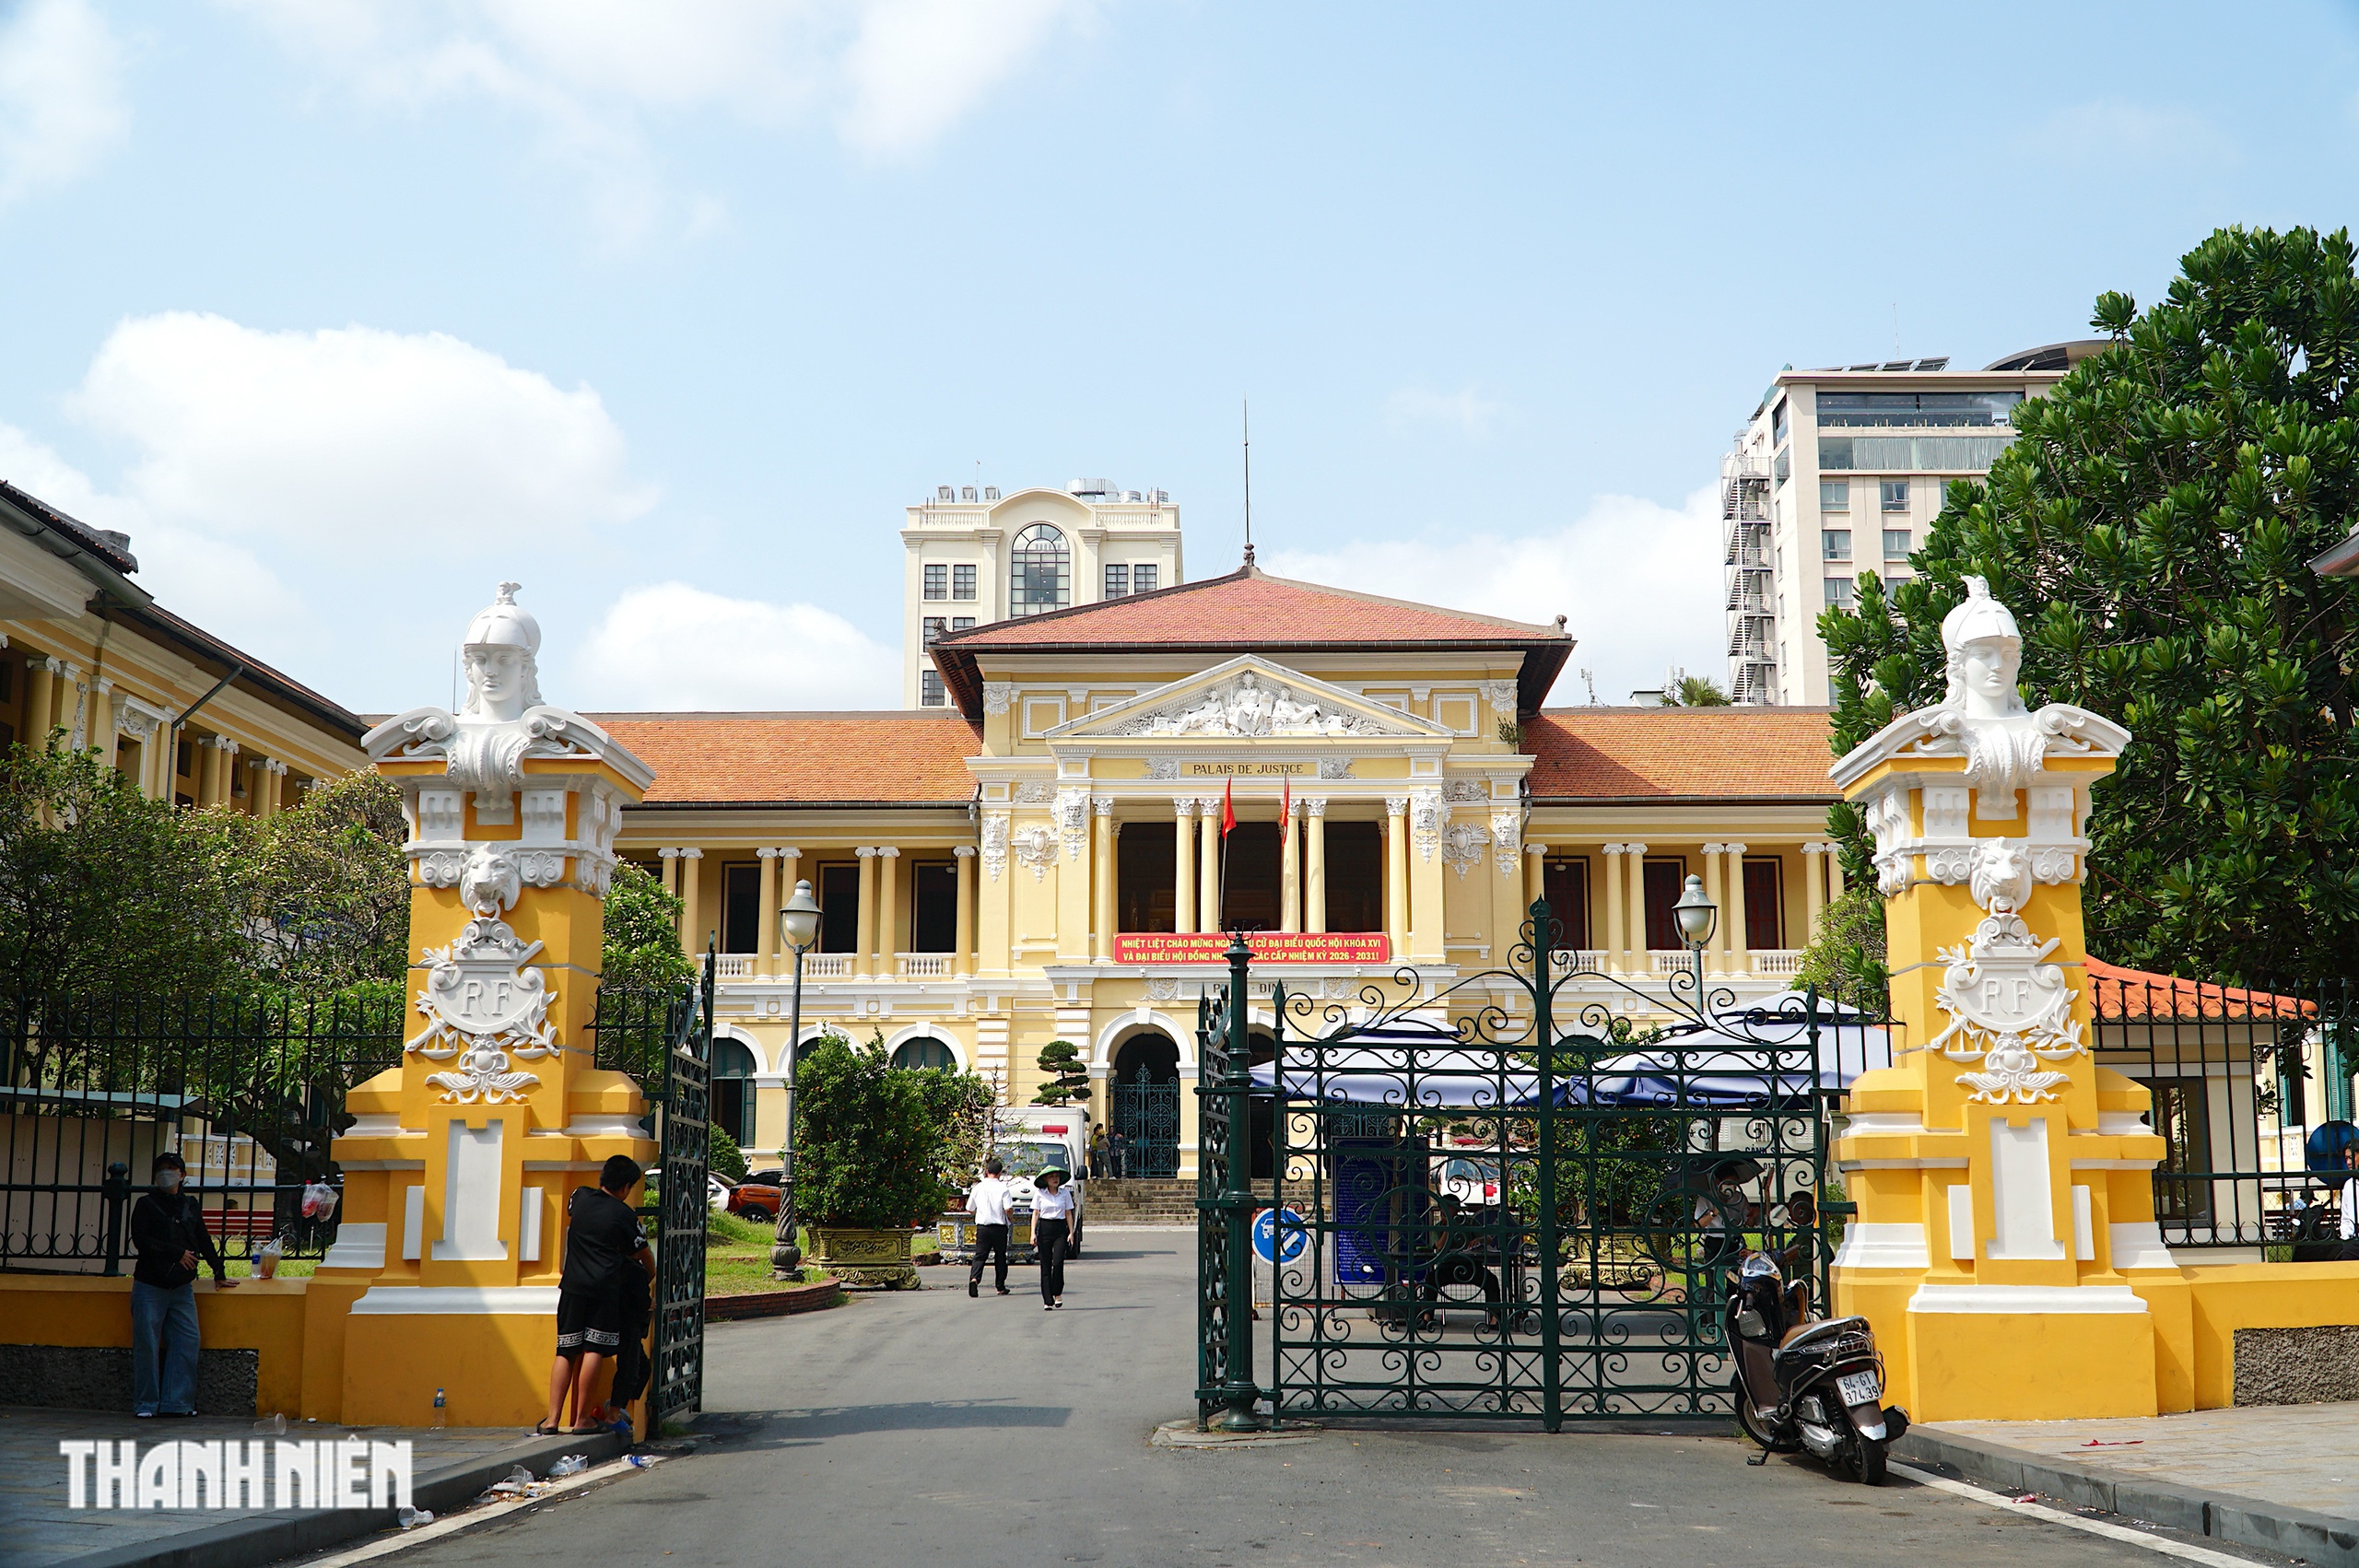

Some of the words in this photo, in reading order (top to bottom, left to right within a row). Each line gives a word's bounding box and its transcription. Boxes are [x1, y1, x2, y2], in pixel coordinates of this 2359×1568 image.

[1193, 764, 1234, 774] PALAIS
[1238, 764, 1252, 774] DE
[1257, 764, 1303, 774] JUSTICE
[1121, 938, 1145, 950] NHIỆT
[1147, 938, 1165, 950] LIỆT
[1167, 938, 1189, 948] CHÀO
[1190, 938, 1213, 948] MỪNG
[1256, 936, 1267, 948] CỬ
[1268, 939, 1283, 950] ĐẠI
[1285, 935, 1304, 948] BIỂU
[1305, 936, 1327, 949] QUỐC
[1328, 937, 1343, 949] HỘI
[1344, 937, 1366, 948] KHÓA
[1367, 939, 1381, 948] XVI
[1122, 949, 1134, 961] VÀ
[1135, 952, 1150, 963] ĐẠI
[1152, 948, 1170, 961] BIỂU
[1172, 950, 1186, 962] HỘI
[1188, 949, 1210, 961] ĐỒNG
[1253, 951, 1270, 961] CÁC
[1271, 949, 1287, 961] CẤP
[1289, 950, 1315, 962] NHIỆM
[1316, 950, 1327, 961] KỲ
[1329, 952, 1350, 961] 2026
[1356, 952, 1379, 961] 2031!
[461, 978, 513, 1017] RF
[1981, 977, 2031, 1015] RF
[1843, 1374, 1872, 1390] 64-G1
[1846, 1386, 1879, 1403] 374.39
